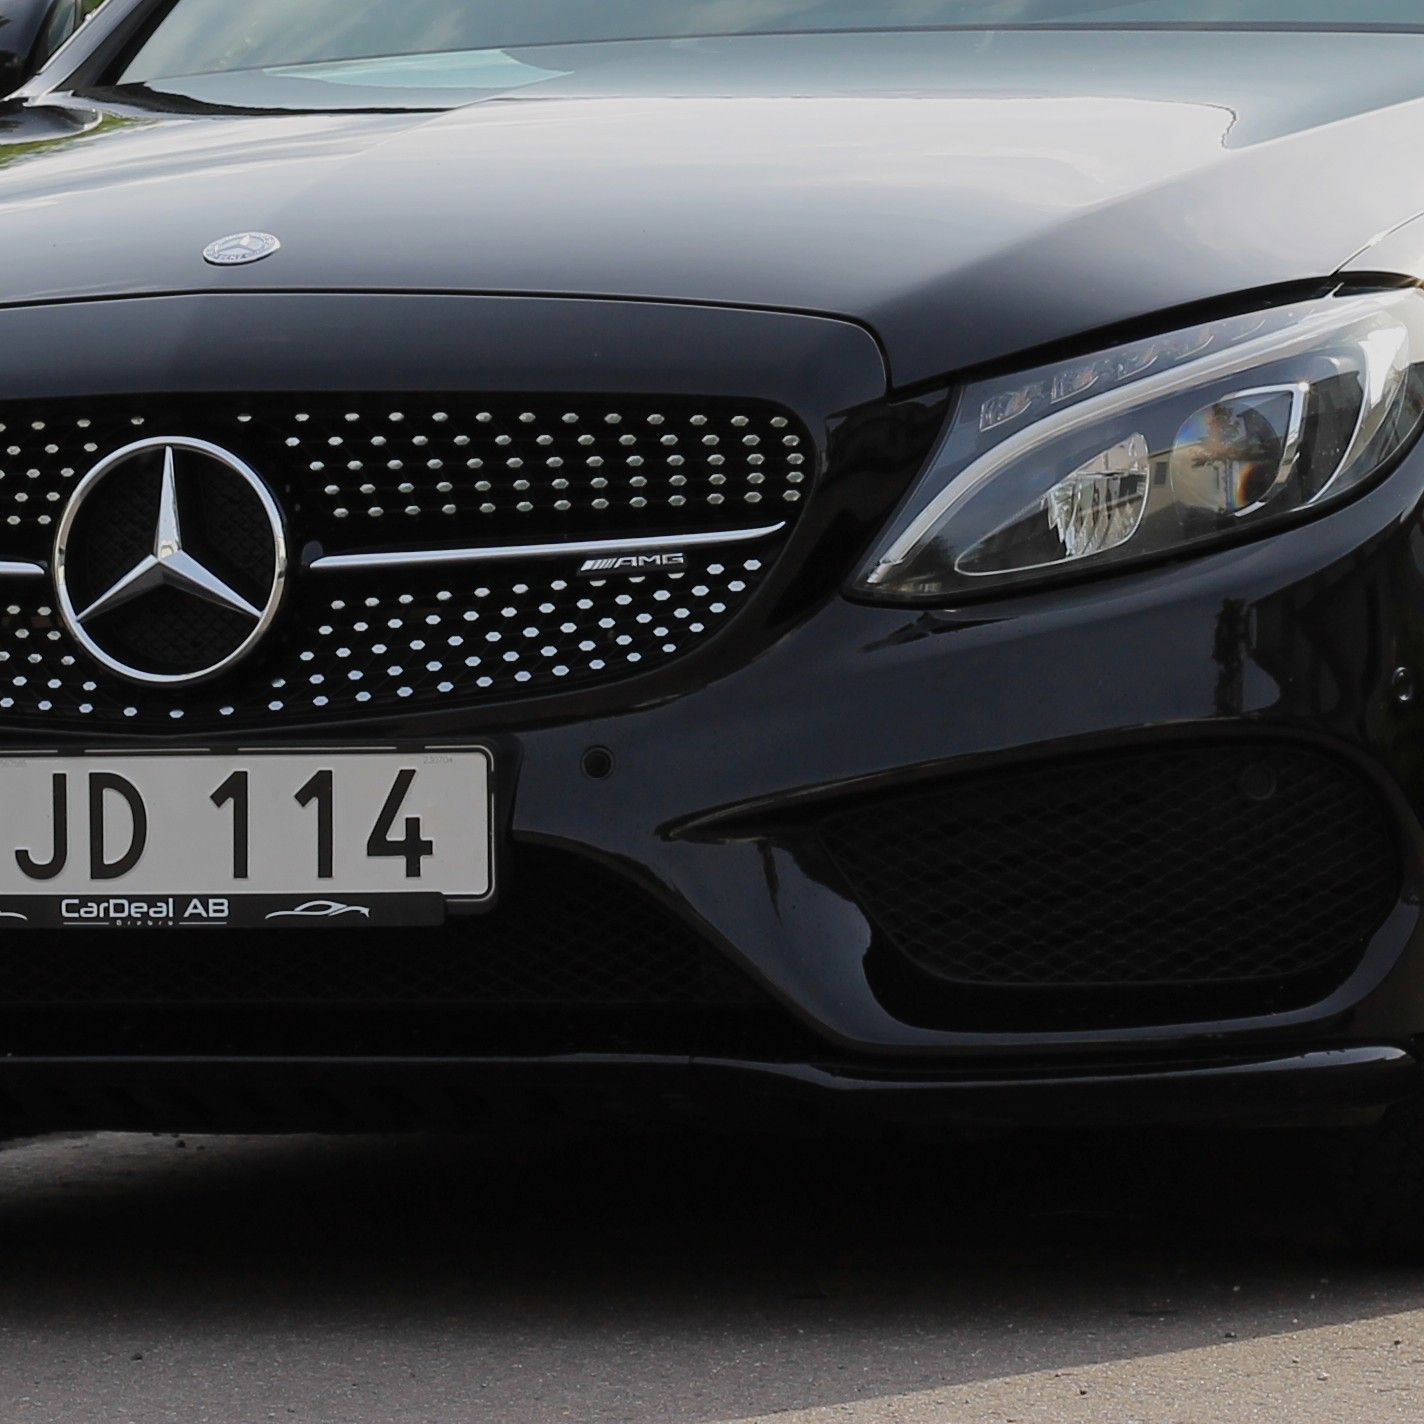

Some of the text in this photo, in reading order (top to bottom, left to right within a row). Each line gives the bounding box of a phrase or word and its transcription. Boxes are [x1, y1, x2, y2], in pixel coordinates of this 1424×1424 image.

[614, 553, 685, 568] AMG
[210, 769, 434, 879] 114
[61, 898, 229, 918] CarDeal AB
